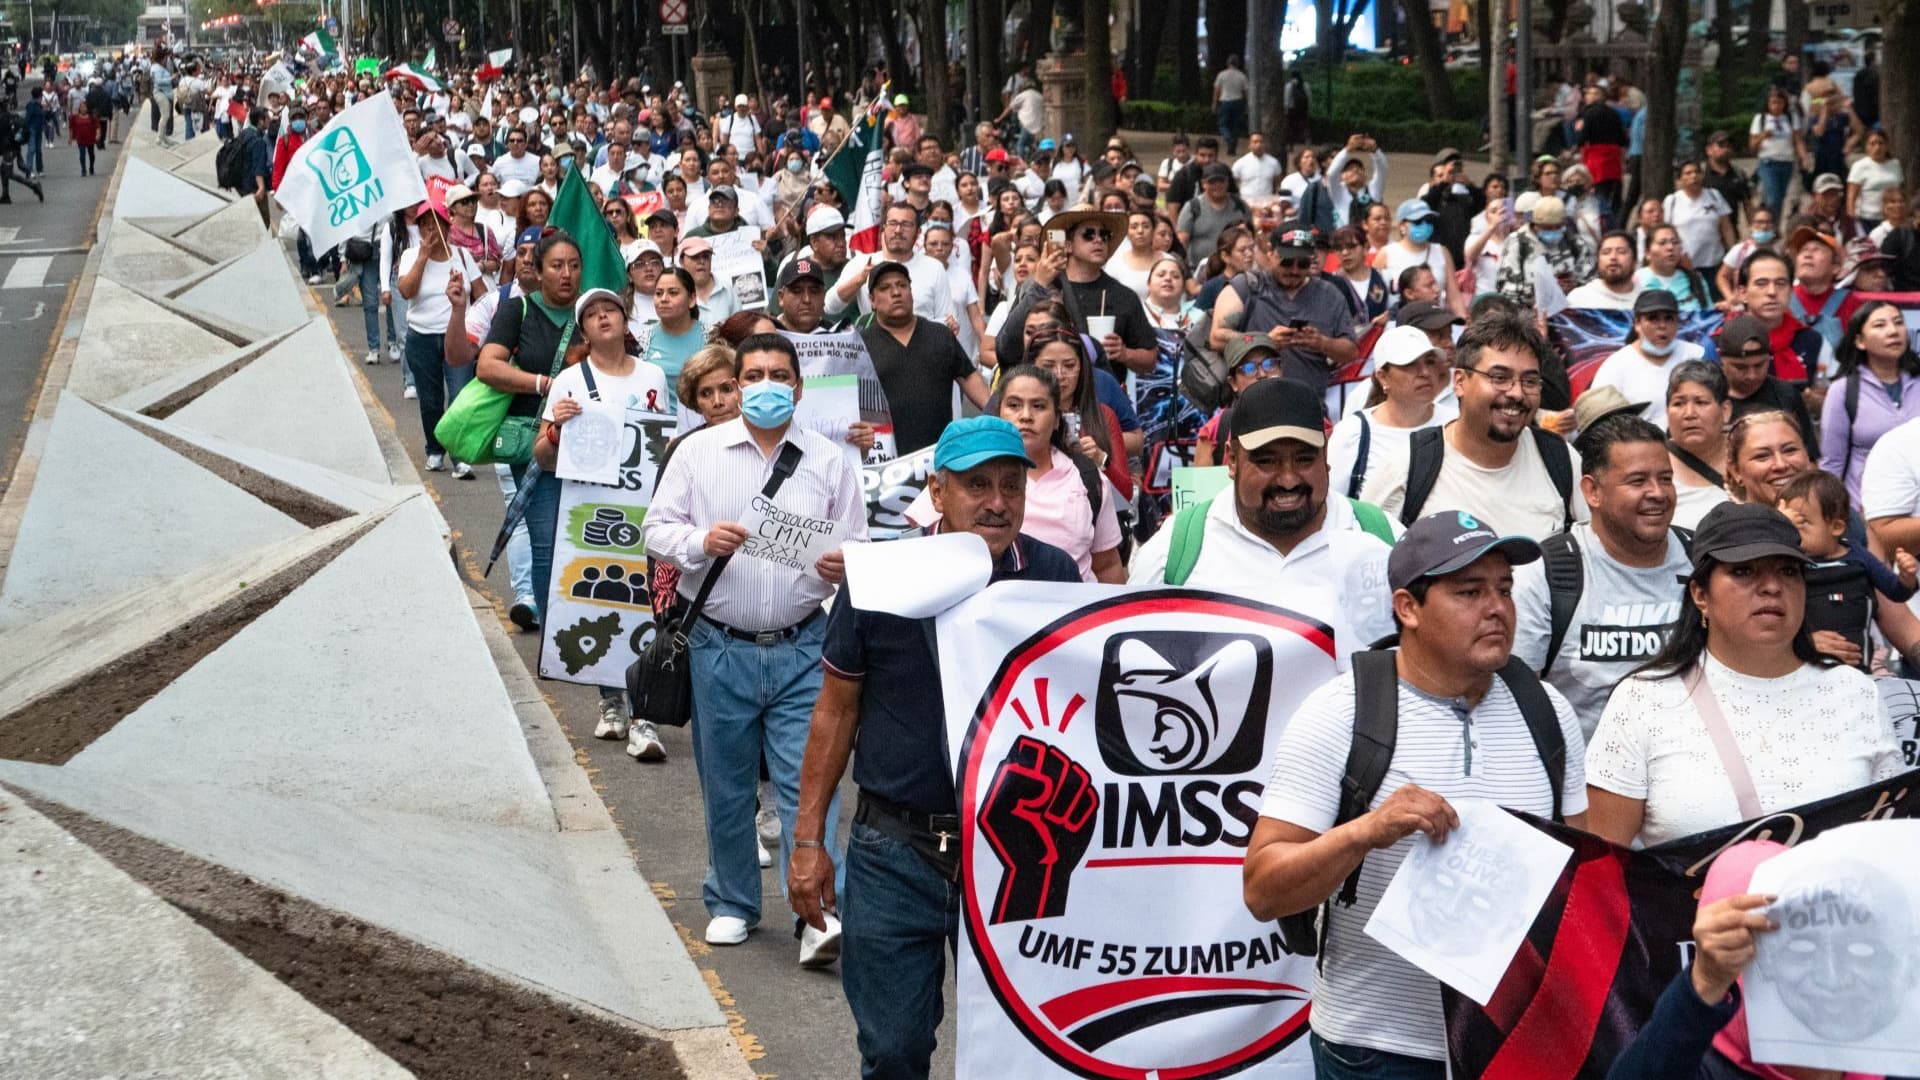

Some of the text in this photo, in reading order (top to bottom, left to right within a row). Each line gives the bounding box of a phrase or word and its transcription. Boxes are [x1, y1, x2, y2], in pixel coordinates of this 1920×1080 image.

[795, 341, 835, 350] EDICINA
[807, 349, 823, 357] DEL
[751, 496, 834, 536] CARDIOLOGIA
[741, 548, 807, 572] NUTRICION
[1582, 631, 1631, 657] JUST
[1631, 631, 1661, 657] DO
[1102, 780, 1266, 849] IMSS
[1787, 902, 1873, 930] OLIVO
[1018, 924, 1294, 976] UMF 55 ZUMPAN
